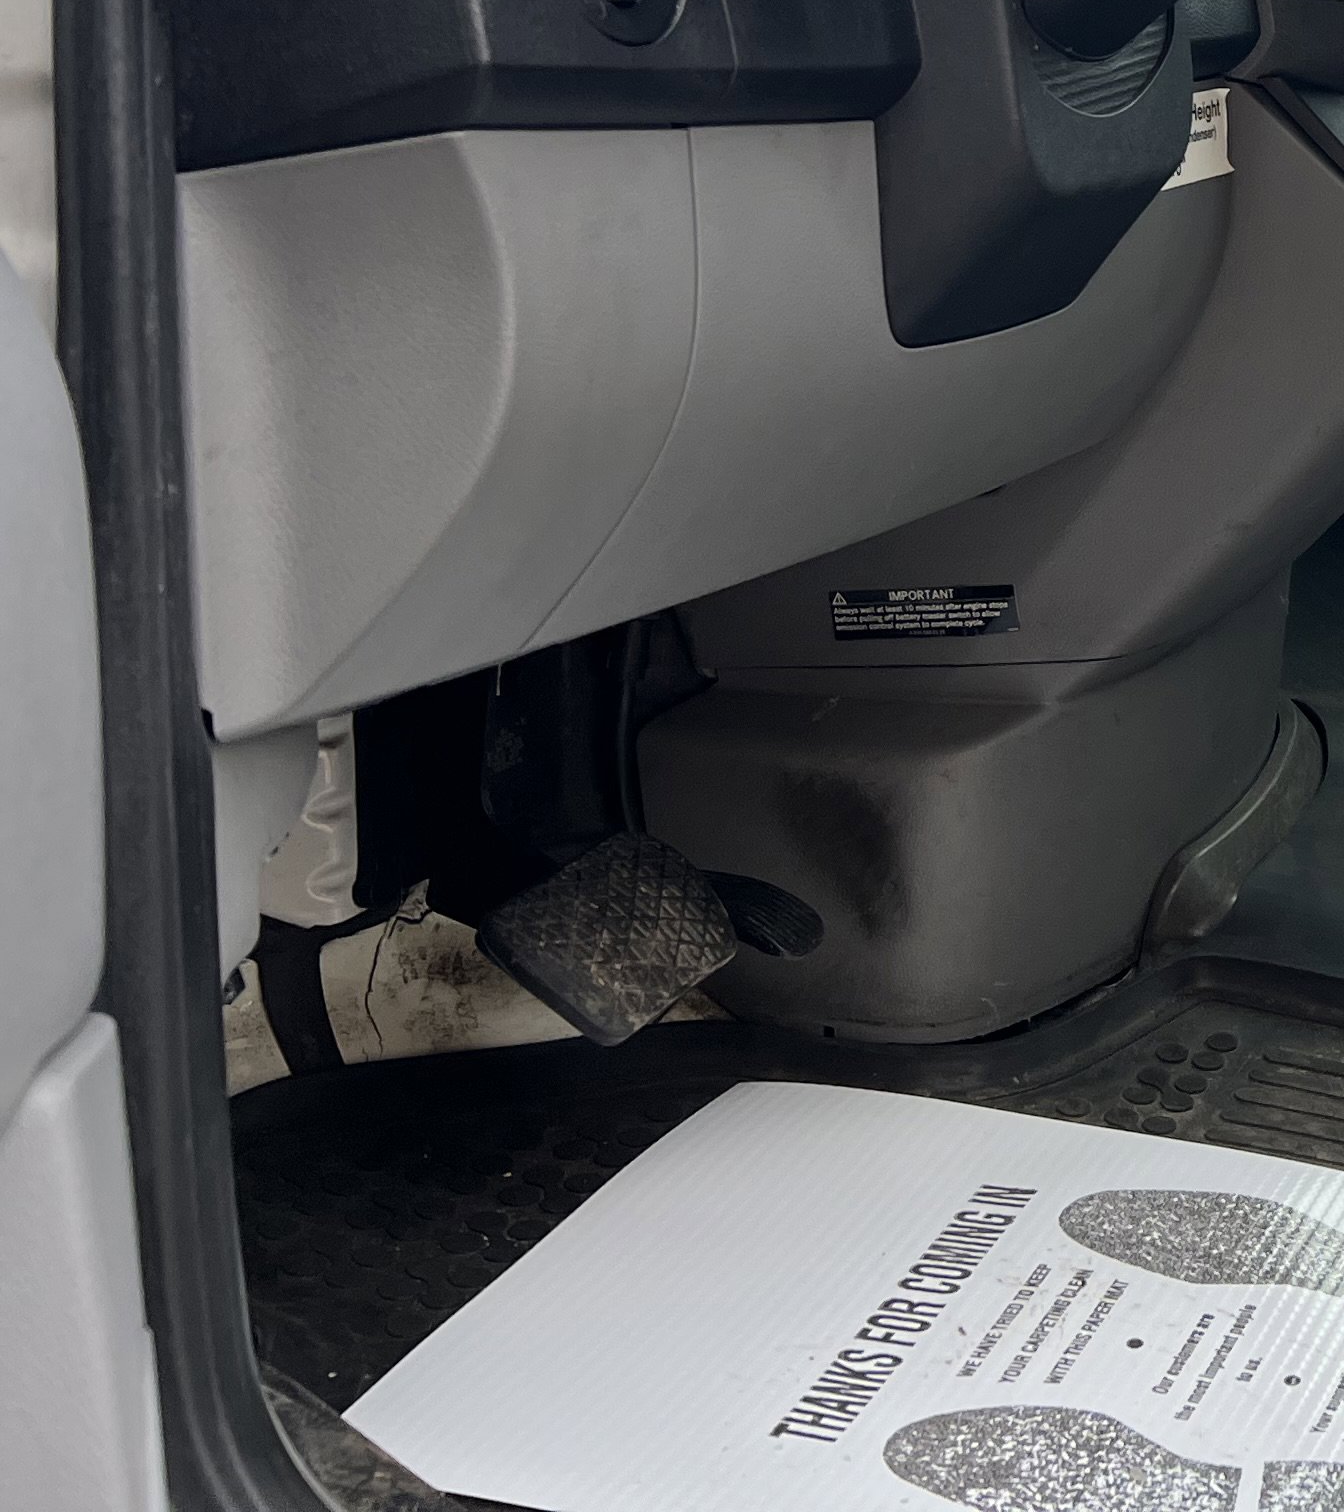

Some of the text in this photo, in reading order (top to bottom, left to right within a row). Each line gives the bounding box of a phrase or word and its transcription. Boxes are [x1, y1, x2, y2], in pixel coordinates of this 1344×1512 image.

[834, 607, 859, 615] Always
[963, 602, 987, 610] engine
[834, 615, 858, 623] before
[895, 613, 921, 621] battery
[888, 588, 954, 601] IMPORTANT
[868, 622, 894, 630] control
[895, 622, 921, 630] system
[930, 620, 963, 628] complete
[768, 1184, 1038, 1443] THANKS FOR COMING IN
[956, 1263, 1052, 1377] WE HAVE TRIED TO KEEP
[997, 1268, 1095, 1383] YOUR CARPETING CLEAN
[1043, 1278, 1130, 1384] WITH THIS PAPER MAT
[1152, 1313, 1215, 1394] Our customers are
[1174, 1304, 1257, 1421] the most important people
[1235, 1372, 1253, 1382] to
[1309, 1412, 1333, 1433] Your
